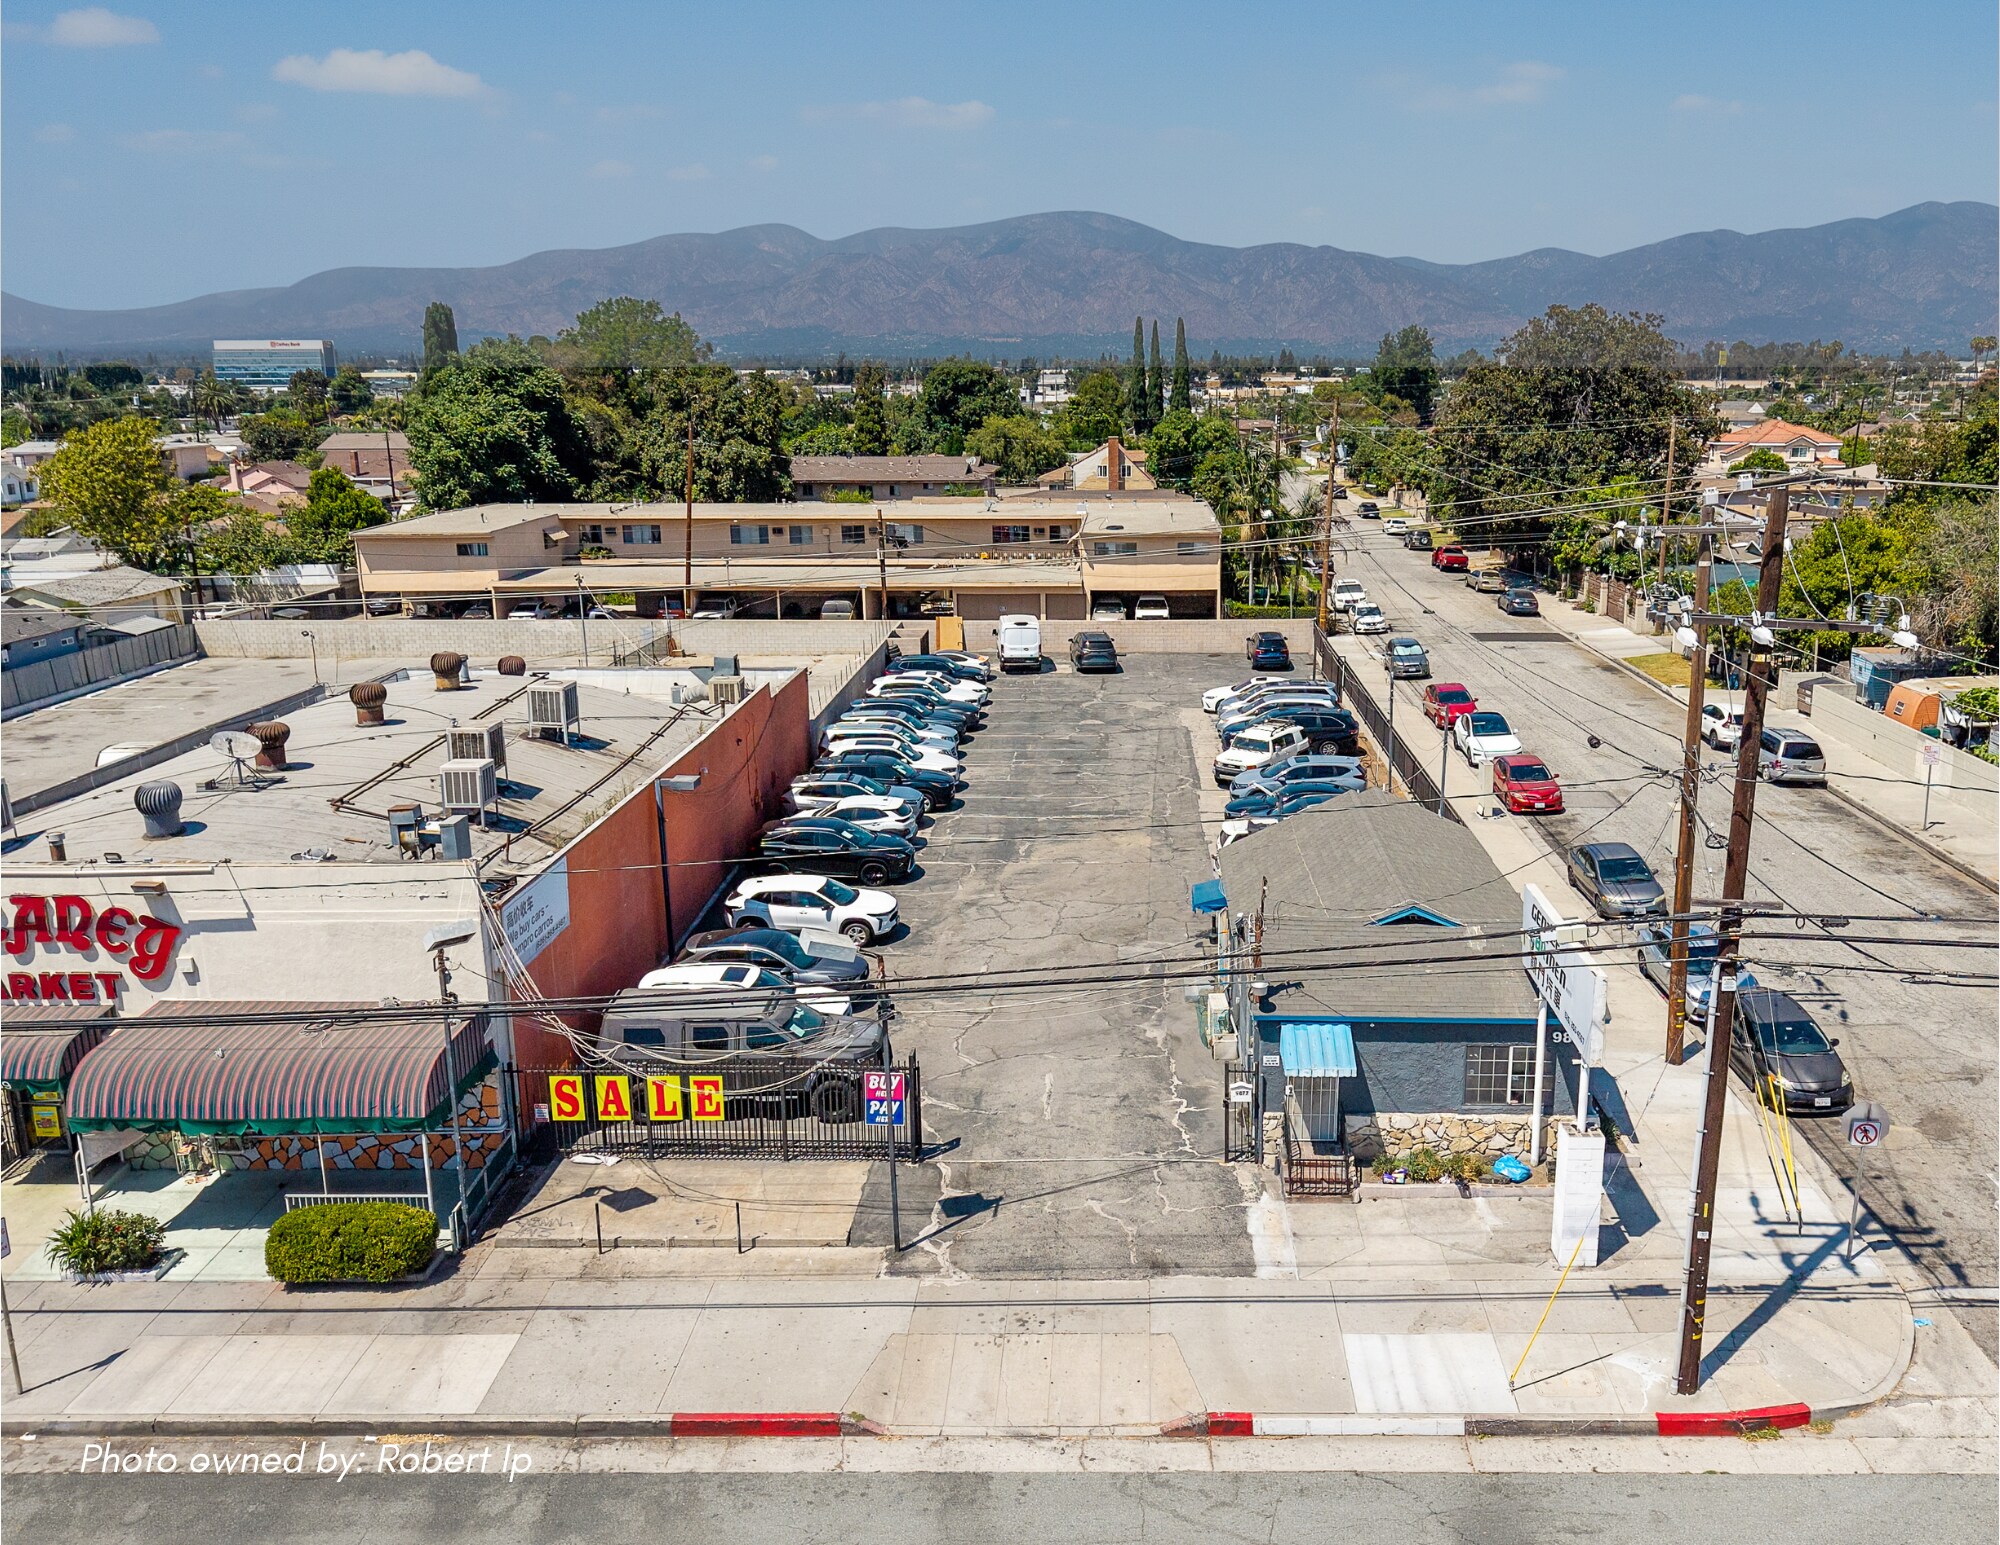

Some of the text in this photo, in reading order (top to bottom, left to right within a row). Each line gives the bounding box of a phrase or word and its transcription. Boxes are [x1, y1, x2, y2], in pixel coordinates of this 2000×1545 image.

[514, 915, 554, 955] ompro carros
[519, 918, 531, 936] buy
[531, 907, 545, 925] cars
[554, 1079, 721, 1118] SALE
[869, 1100, 900, 1115] PAY
